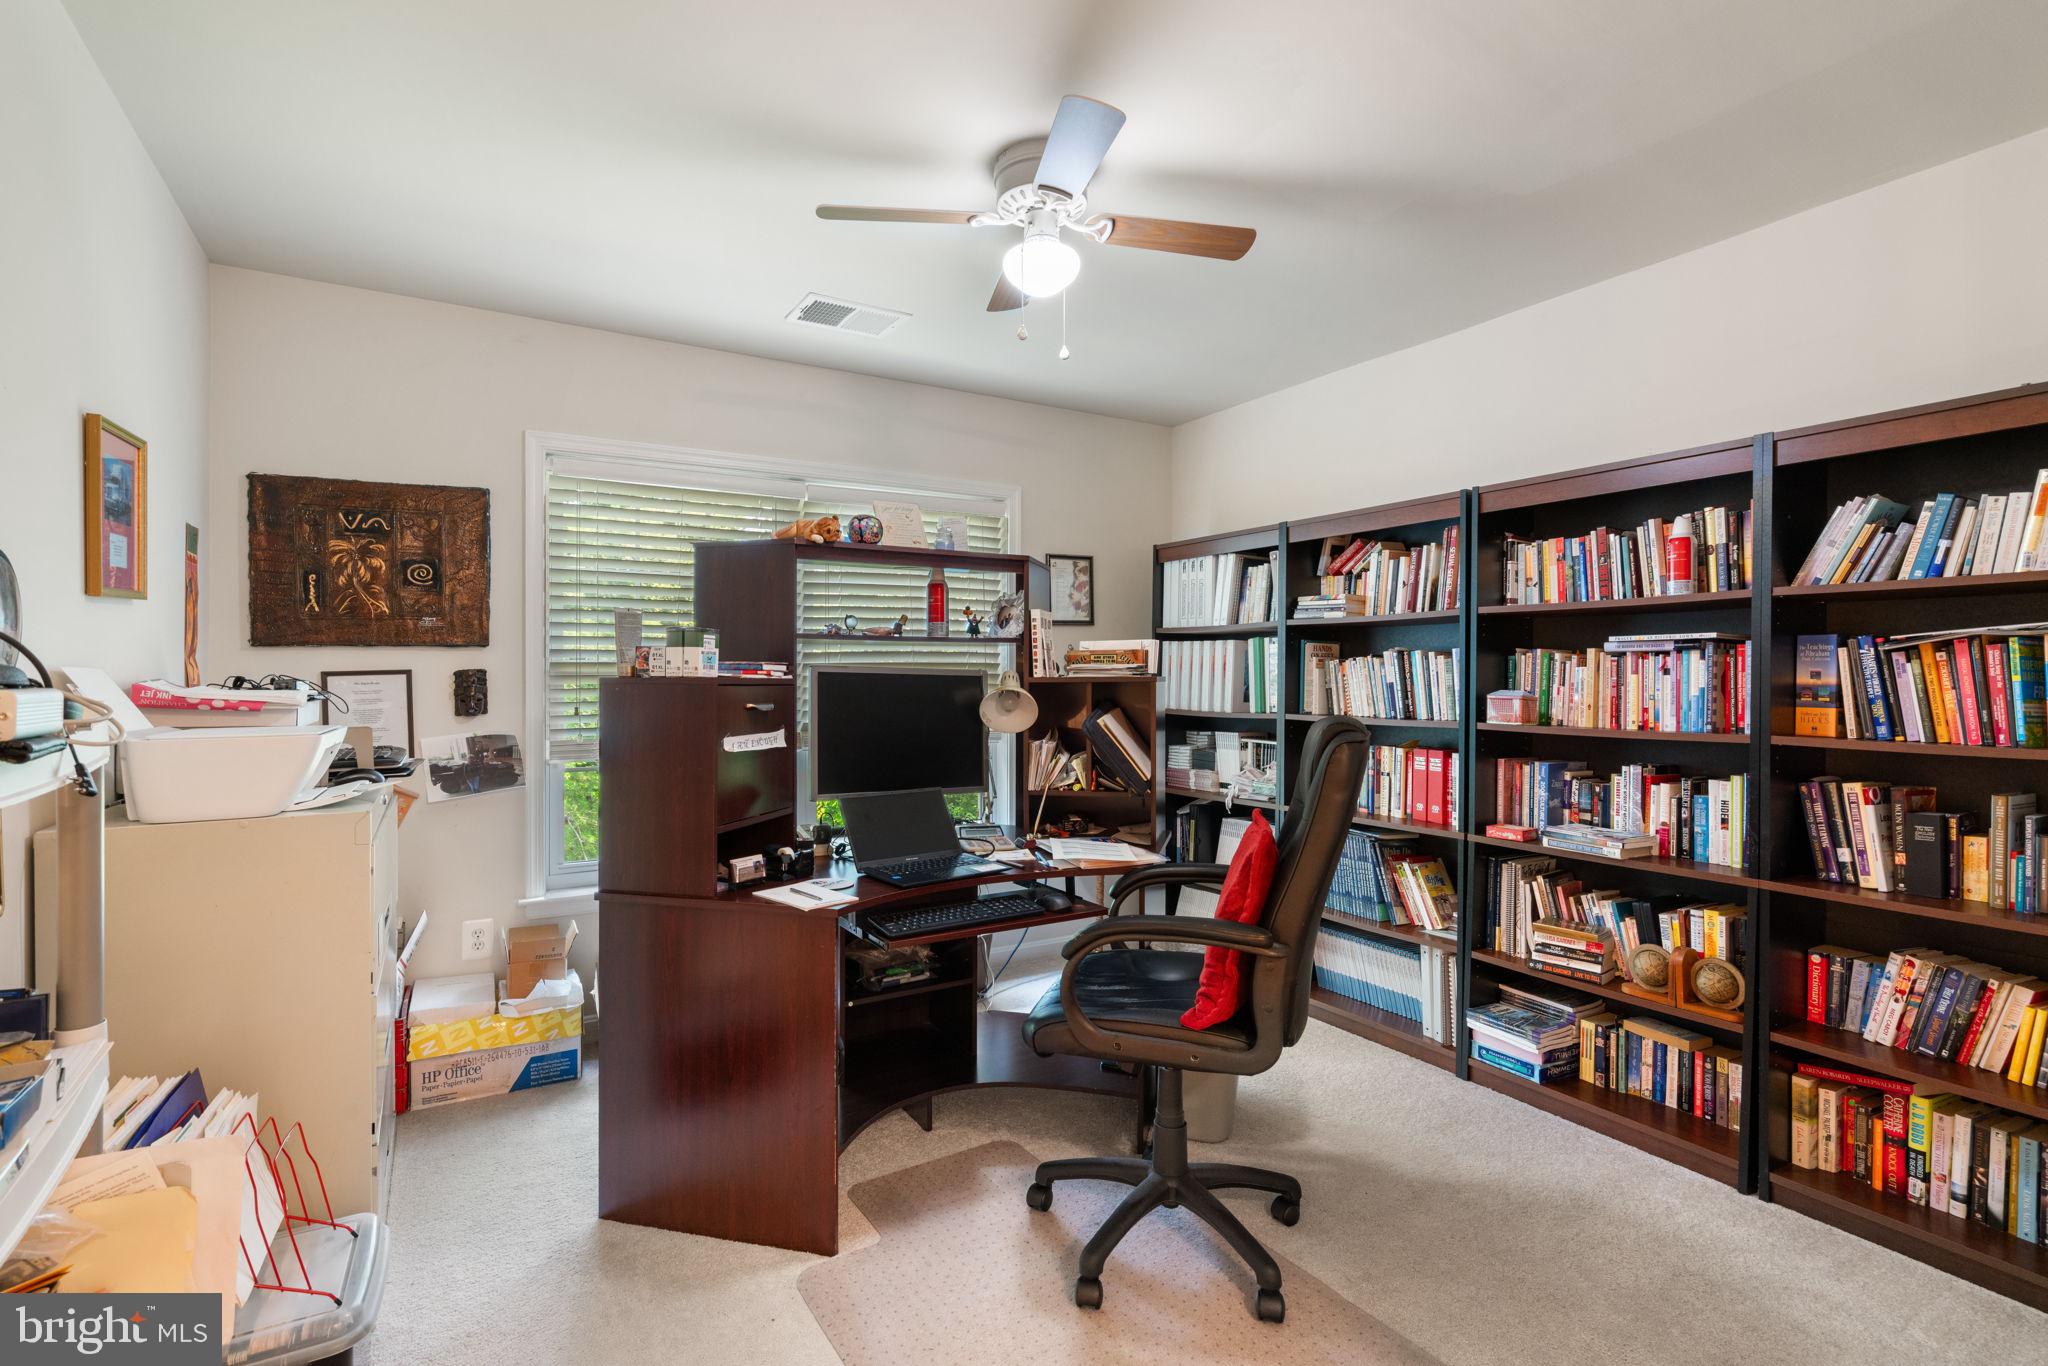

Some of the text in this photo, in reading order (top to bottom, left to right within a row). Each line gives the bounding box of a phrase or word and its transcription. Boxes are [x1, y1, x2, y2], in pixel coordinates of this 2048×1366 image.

[1446, 547, 1456, 592] SEXUAL SECRETS
[1861, 654, 1875, 698] EFFECTIVE PEOPLE
[1867, 654, 1878, 673] HABITS
[140, 689, 172, 699] INK JET
[1939, 662, 1954, 709] ECKHART TOLLE
[139, 698, 189, 706] CHAMPION
[1721, 800, 1730, 818] HIDE
[1849, 794, 1865, 850] ONE MINUTE MILLIONAIRE
[1895, 804, 1905, 851] MOON WOMEN
[1706, 914, 1715, 952] MORNING
[1553, 967, 1571, 976] GARDNER
[1809, 965, 1822, 1006] Dictionary
[1883, 1008, 1896, 1036] MEG CABOT
[422, 1065, 481, 1085] HP Office
[1548, 1063, 1577, 1076] HAMMER
[1800, 1067, 1822, 1075] KAREN
[1884, 1094, 1894, 1131] COULTER
[1893, 1097, 1905, 1134] CATHERINE
[1911, 1122, 1924, 1146] ROBB
[1887, 1146, 1897, 1189] KNOCK OUT
[1916, 1155, 1924, 1178] KINDRED
[2024, 1191, 2032, 1208] LOOK
